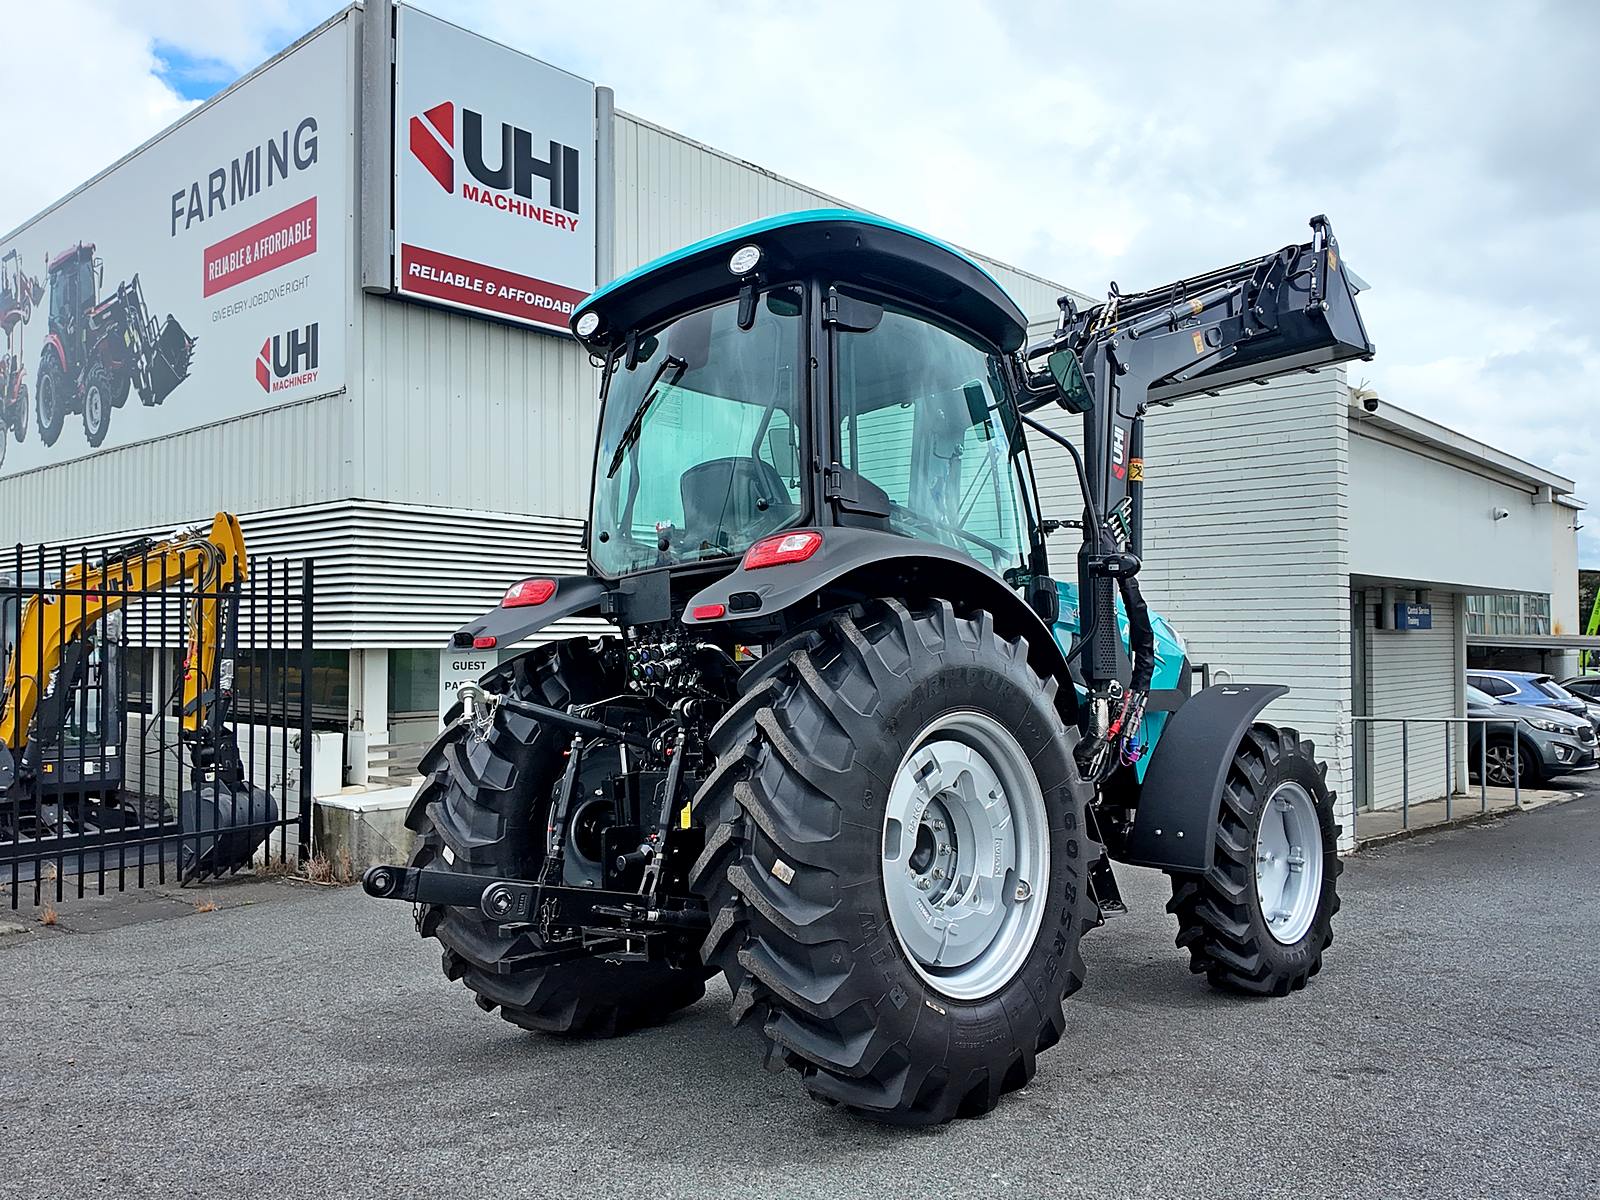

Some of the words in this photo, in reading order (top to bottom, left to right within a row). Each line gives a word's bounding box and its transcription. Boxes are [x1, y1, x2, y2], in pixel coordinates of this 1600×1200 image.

[171, 117, 318, 237] FARMING
[462, 108, 579, 215] UHI
[463, 183, 578, 232] MACHINERY
[208, 248, 245, 281] RELIABLE
[245, 245, 252, 265] &
[253, 217, 312, 262] AFFORDABLE
[212, 307, 226, 322] GIVE
[227, 300, 247, 317] EVERY
[248, 293, 263, 309] JOB
[263, 284, 286, 303] DONE
[286, 275, 310, 293] RIGHT
[408, 262, 483, 292] RELIABLE
[485, 282, 497, 295] &
[498, 286, 575, 315] AFFORDABL
[273, 322, 318, 378] UHI
[273, 371, 318, 392] MACHINERY
[1113, 425, 1124, 465] UHI
[452, 661, 487, 671] GUEST
